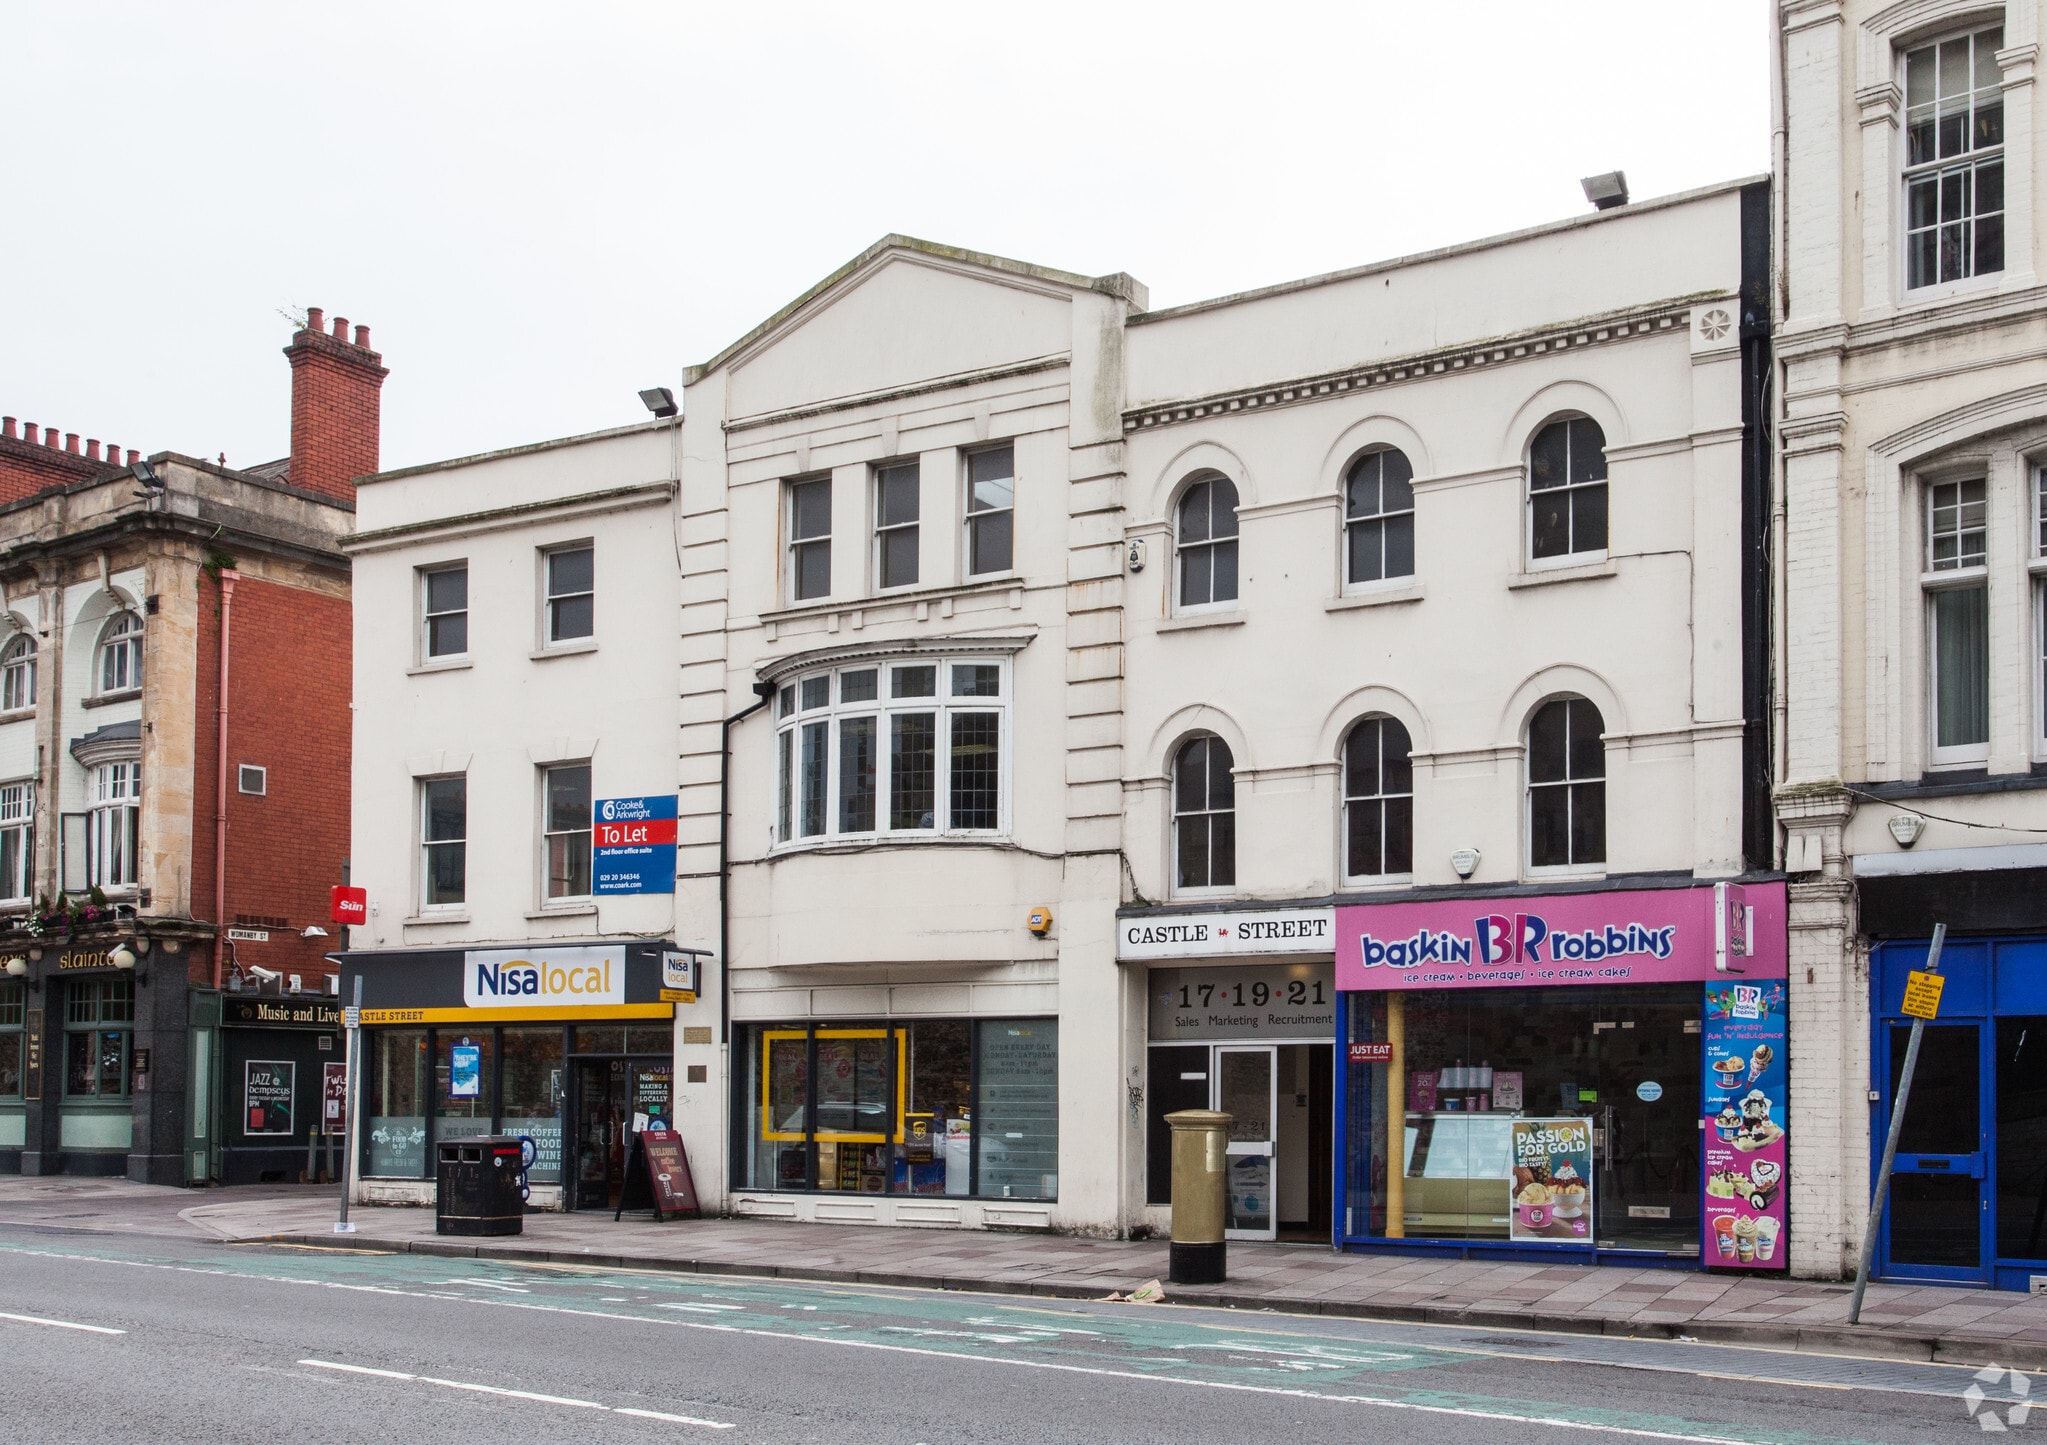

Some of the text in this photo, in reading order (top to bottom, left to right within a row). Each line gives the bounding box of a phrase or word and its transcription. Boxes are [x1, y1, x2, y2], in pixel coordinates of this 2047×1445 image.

[616, 809, 651, 819] Arkwright
[601, 821, 648, 843] To Let
[1128, 919, 1327, 944] CASTLE STREET
[1362, 931, 1471, 966] baskin
[1475, 915, 1547, 965] BR
[668, 959, 688, 971] Nisa
[478, 959, 611, 996] Nisa local
[668, 972, 688, 983] local
[1404, 966, 1632, 982] ice cream beverages ice cream cakes
[257, 1004, 288, 1020] Music
[293, 1007, 313, 1022] and
[317, 1007, 339, 1021] Live
[360, 1012, 387, 1020] ASTLE
[389, 1011, 424, 1020] STREET
[1175, 1013, 1333, 1028] Sales Marketing Recruitment
[1350, 1045, 1390, 1054] JUST EAT
[249, 1073, 271, 1085] JAZZ
[502, 1128, 528, 1136] FRESH
[1517, 1128, 1584, 1144] PASSION
[1518, 1141, 1586, 1156] FOR GOLD
